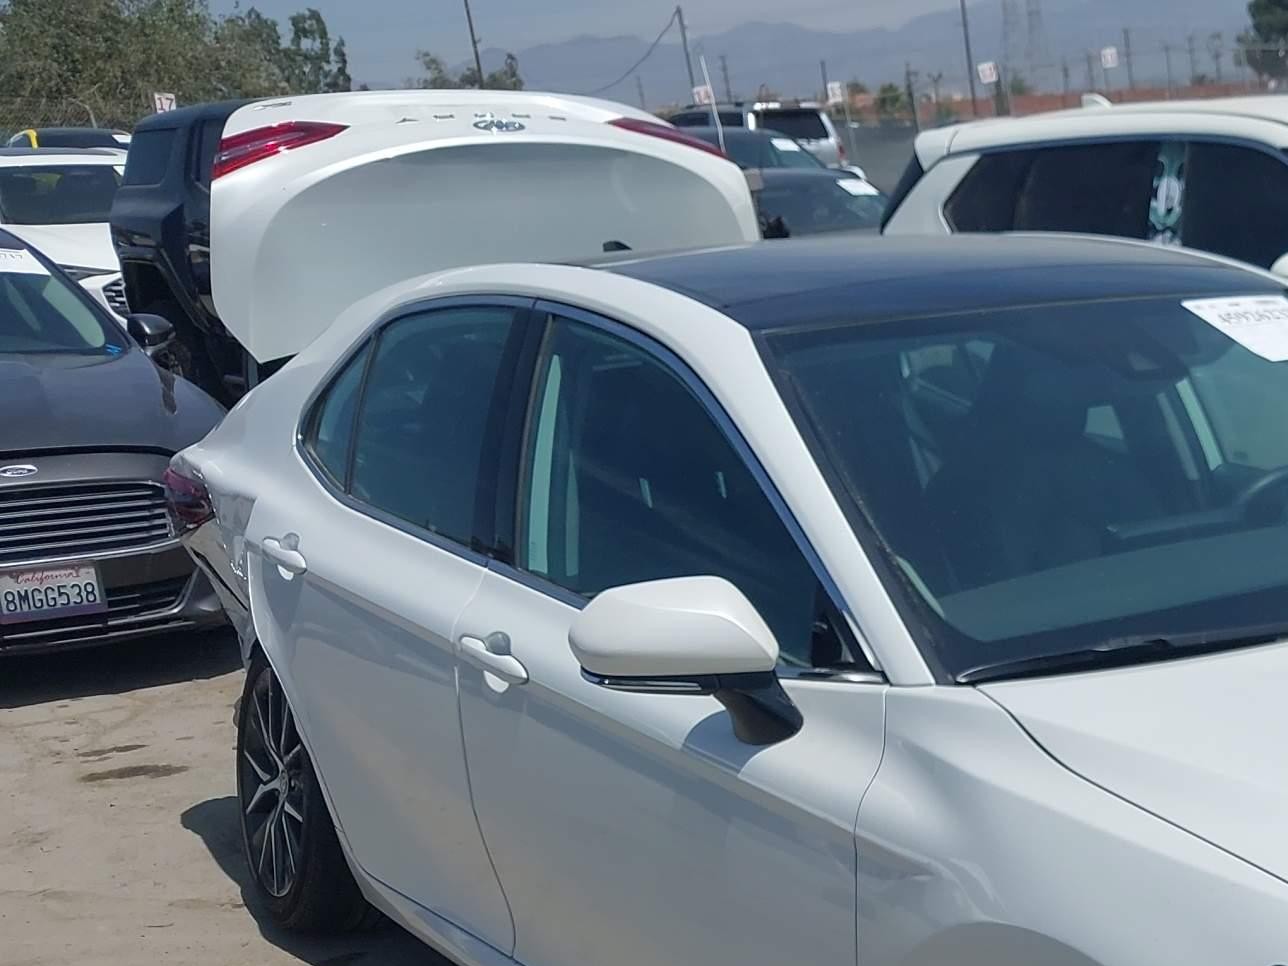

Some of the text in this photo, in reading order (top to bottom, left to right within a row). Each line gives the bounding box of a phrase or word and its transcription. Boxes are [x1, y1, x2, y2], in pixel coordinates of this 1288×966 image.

[157, 96, 174, 112] 17
[16, 567, 74, 585] California
[3, 581, 97, 613] 8MGG538
